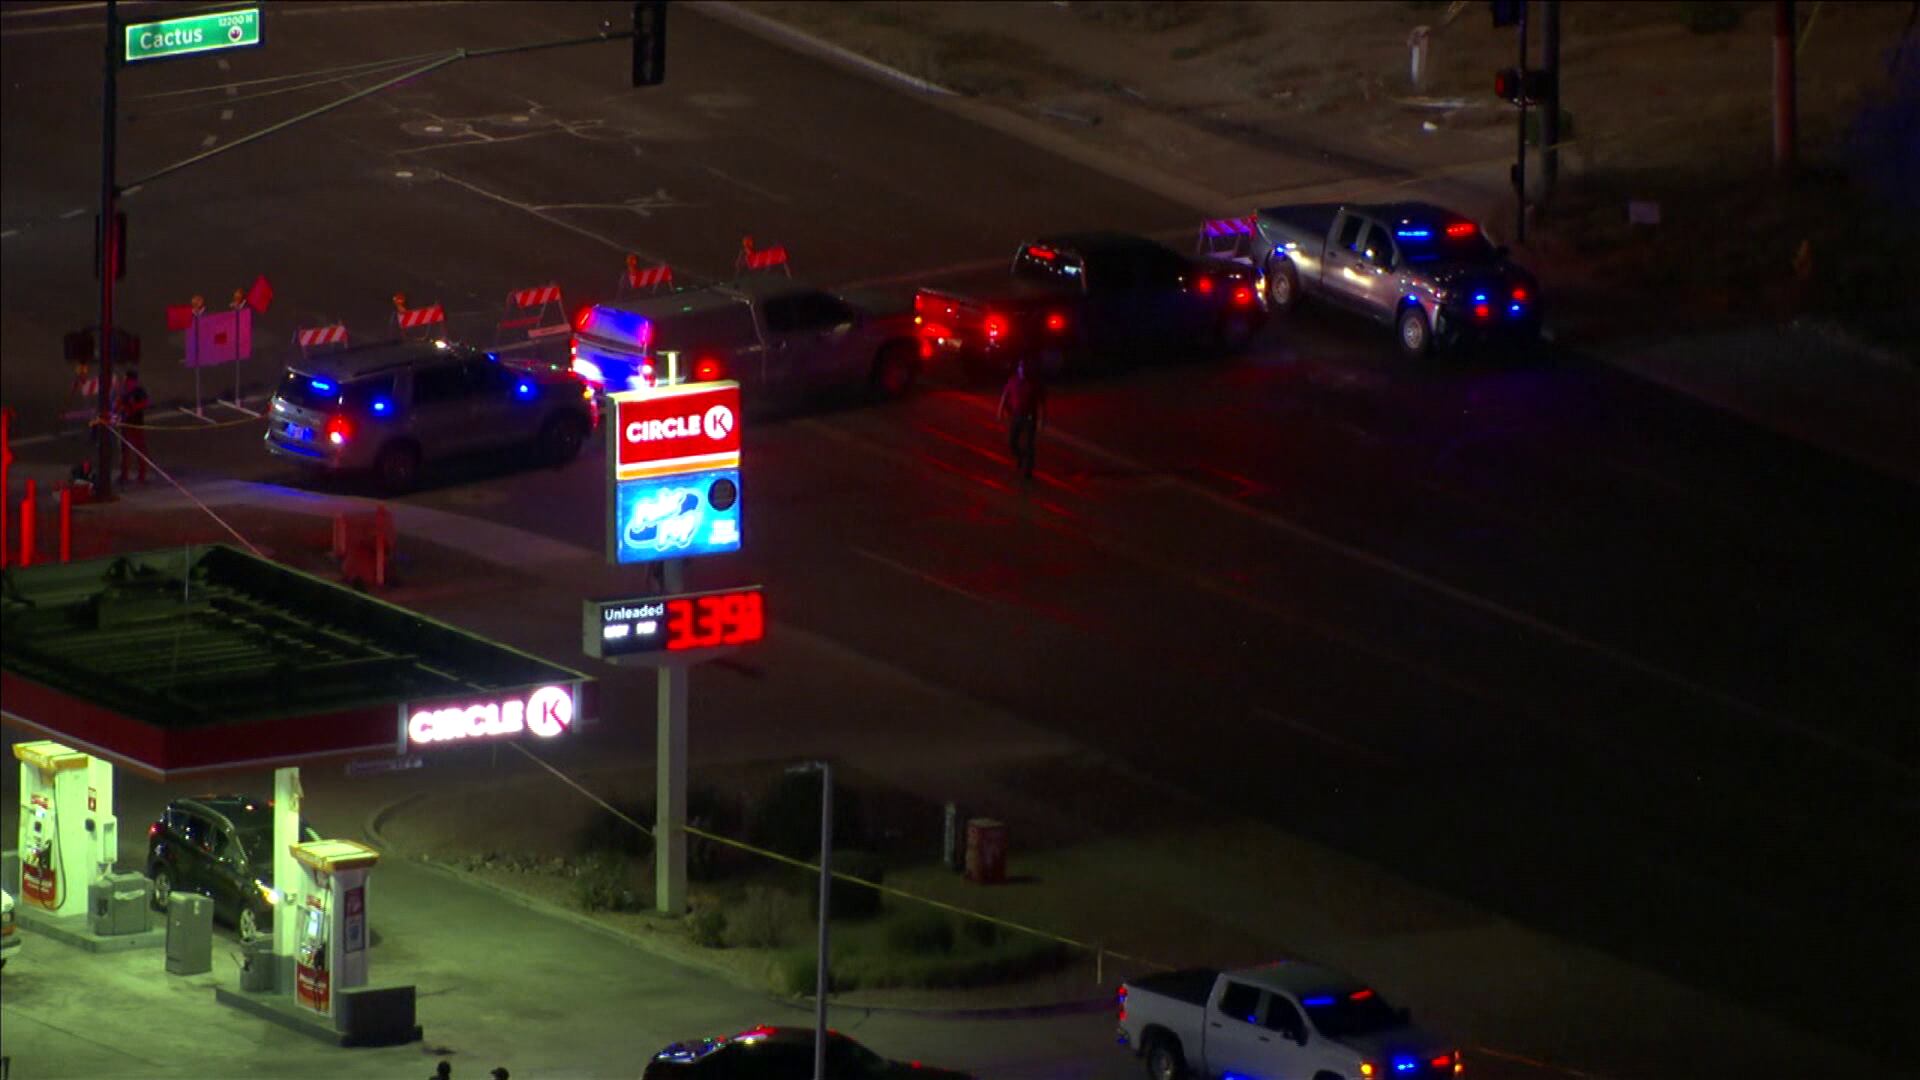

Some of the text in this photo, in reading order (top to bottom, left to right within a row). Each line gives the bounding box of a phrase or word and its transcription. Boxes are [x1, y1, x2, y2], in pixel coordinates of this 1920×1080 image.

[140, 28, 203, 49] Cactus
[626, 414, 701, 443] CIRCLE
[605, 603, 664, 621] Unleaded
[409, 699, 524, 743] CIRCLE
